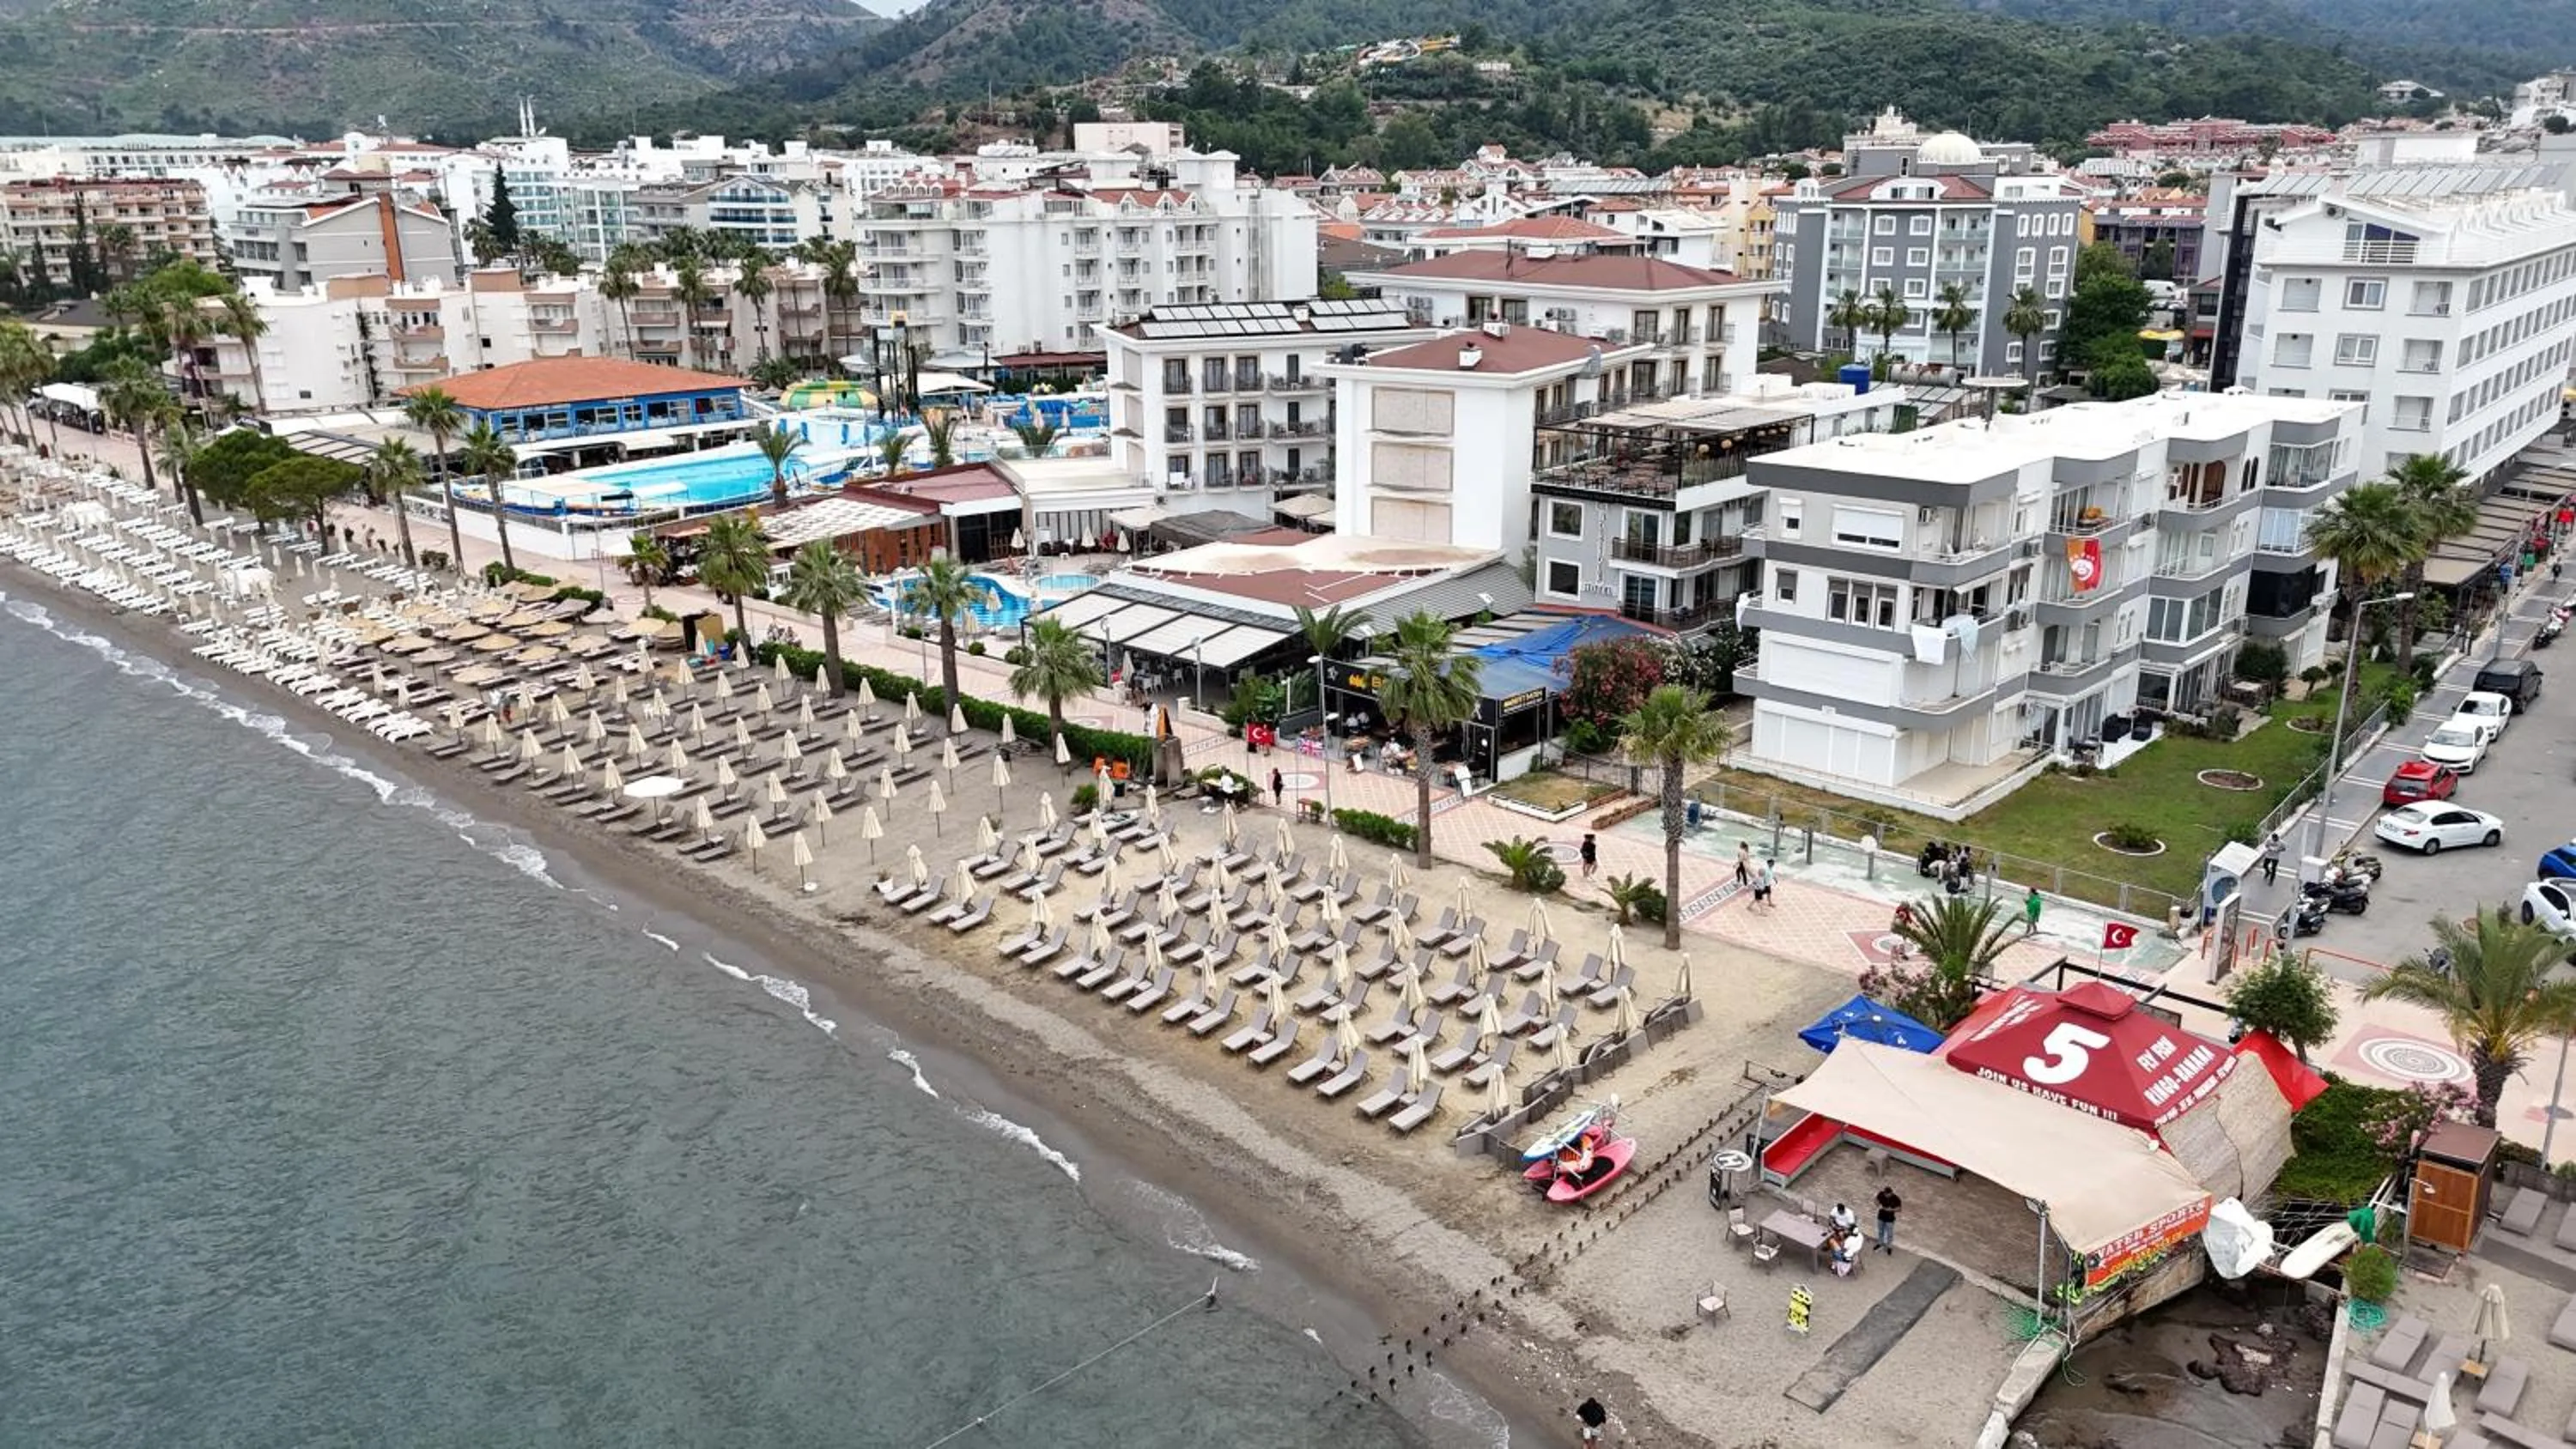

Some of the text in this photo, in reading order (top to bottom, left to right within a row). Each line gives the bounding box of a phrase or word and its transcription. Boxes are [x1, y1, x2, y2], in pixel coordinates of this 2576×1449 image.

[2022, 1022, 2111, 1085] 5
[1977, 1066, 2008, 1085] JOIN
[2011, 1077, 2030, 1093] US
[2032, 1084, 2068, 1106] HAVE
[2071, 1098, 2099, 1116] FUN
